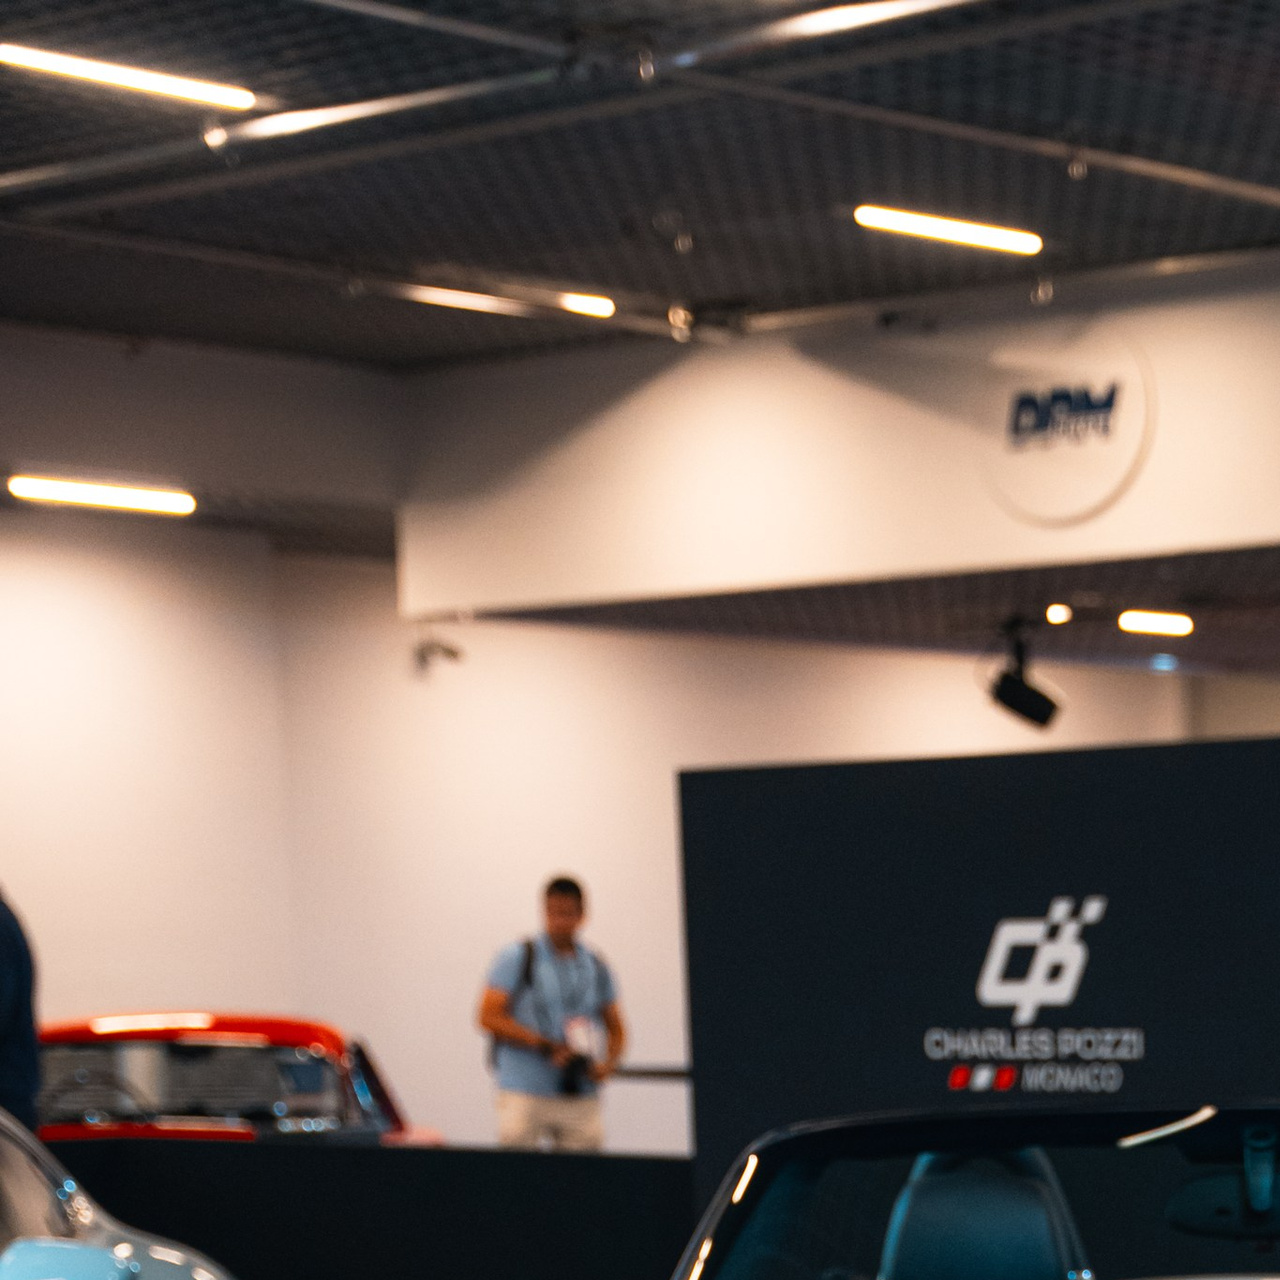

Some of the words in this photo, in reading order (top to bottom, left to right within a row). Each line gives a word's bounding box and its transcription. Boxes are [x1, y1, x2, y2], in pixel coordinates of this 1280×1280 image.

[924, 1028, 1055, 1060] CHARLES
[1057, 1028, 1145, 1060] POZZI
[1021, 1062, 1124, 1092] MONACO
